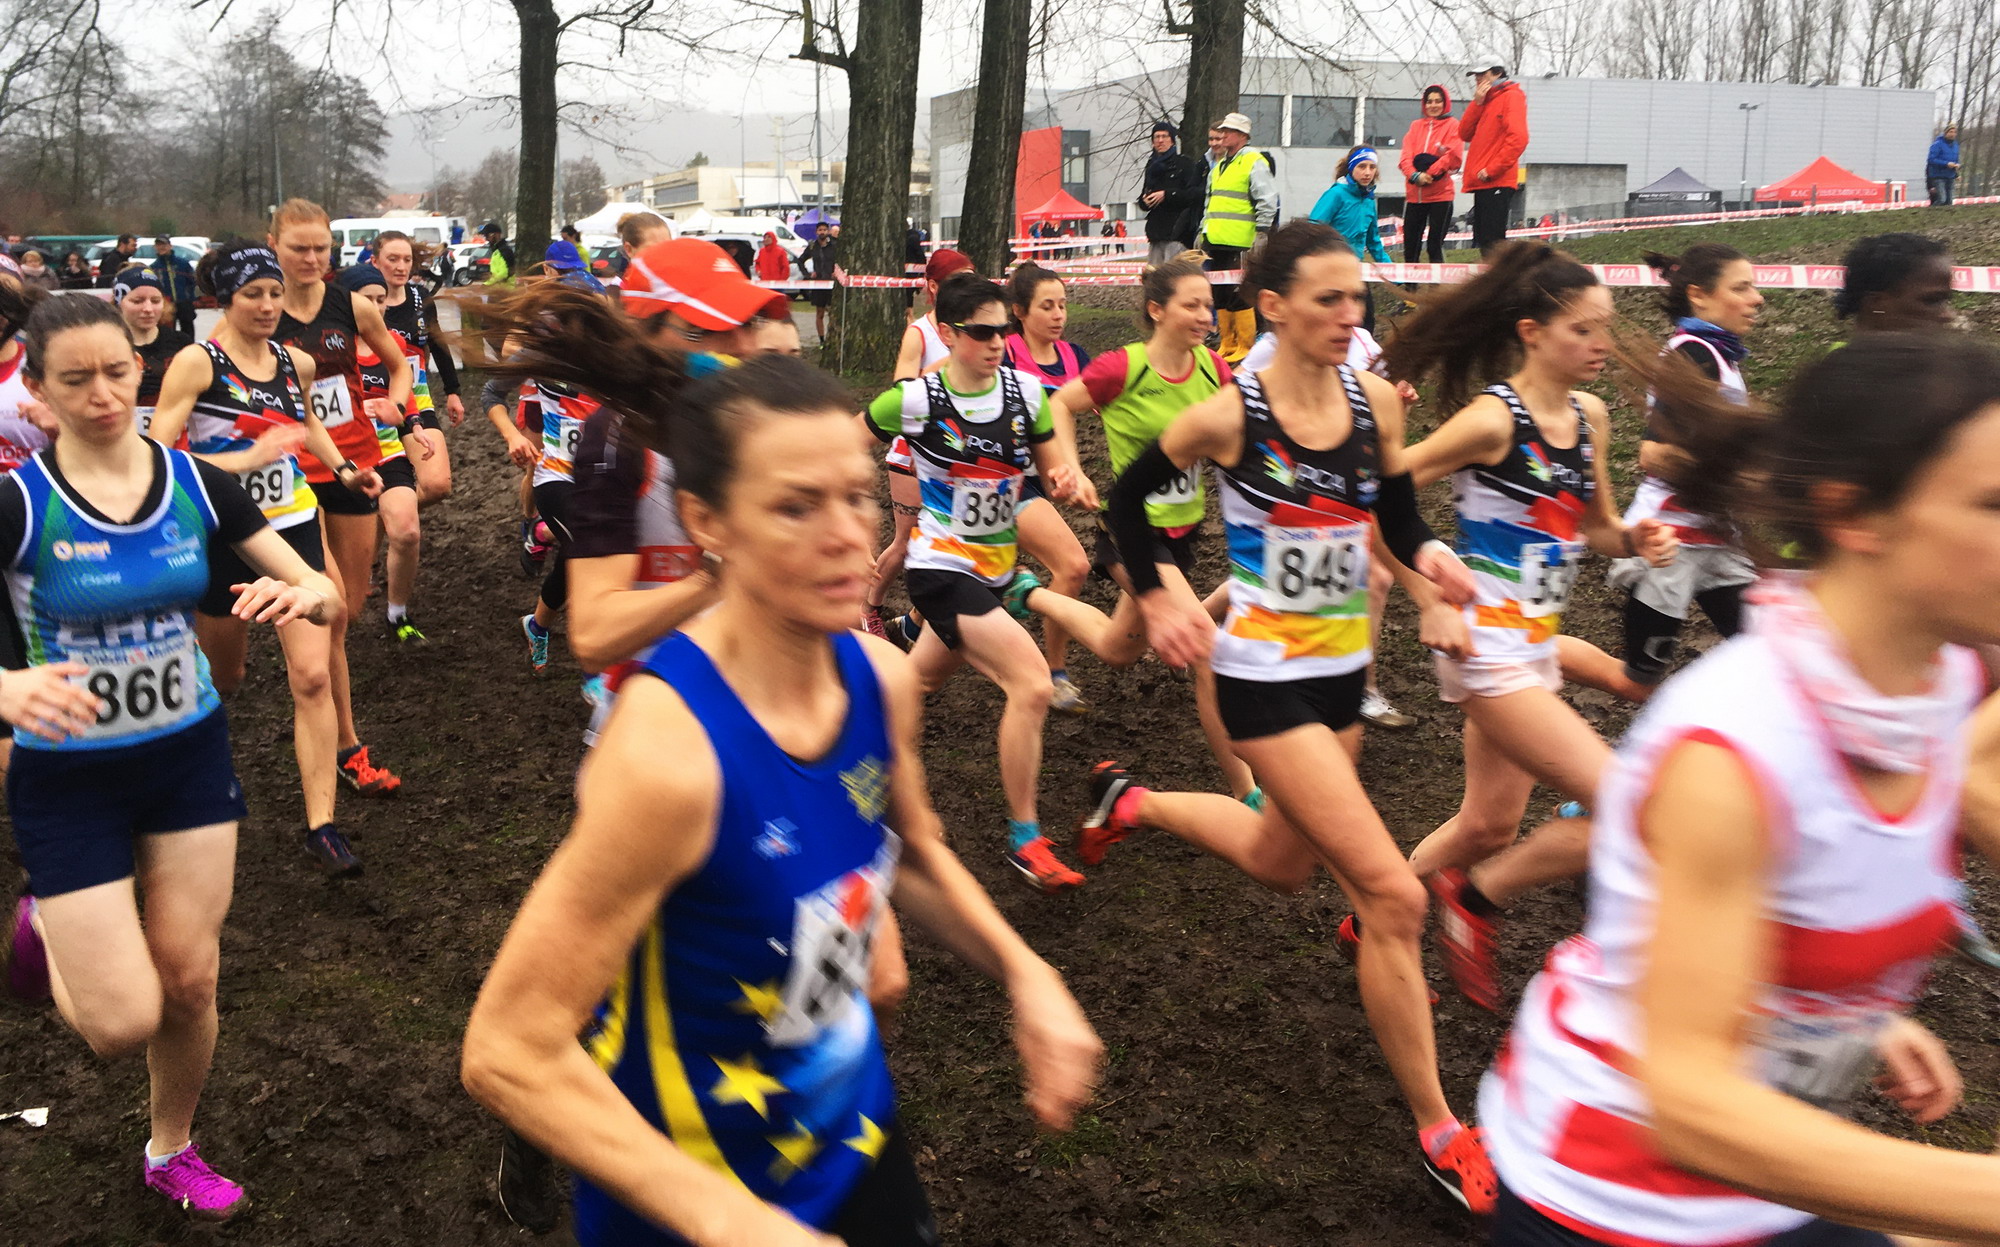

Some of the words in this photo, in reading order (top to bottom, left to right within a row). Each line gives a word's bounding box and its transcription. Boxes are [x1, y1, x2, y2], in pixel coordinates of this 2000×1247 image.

[251, 387, 284, 410] PCA
[966, 434, 1004, 457] PCA
[237, 468, 283, 504] 69
[88, 657, 183, 726] 866
